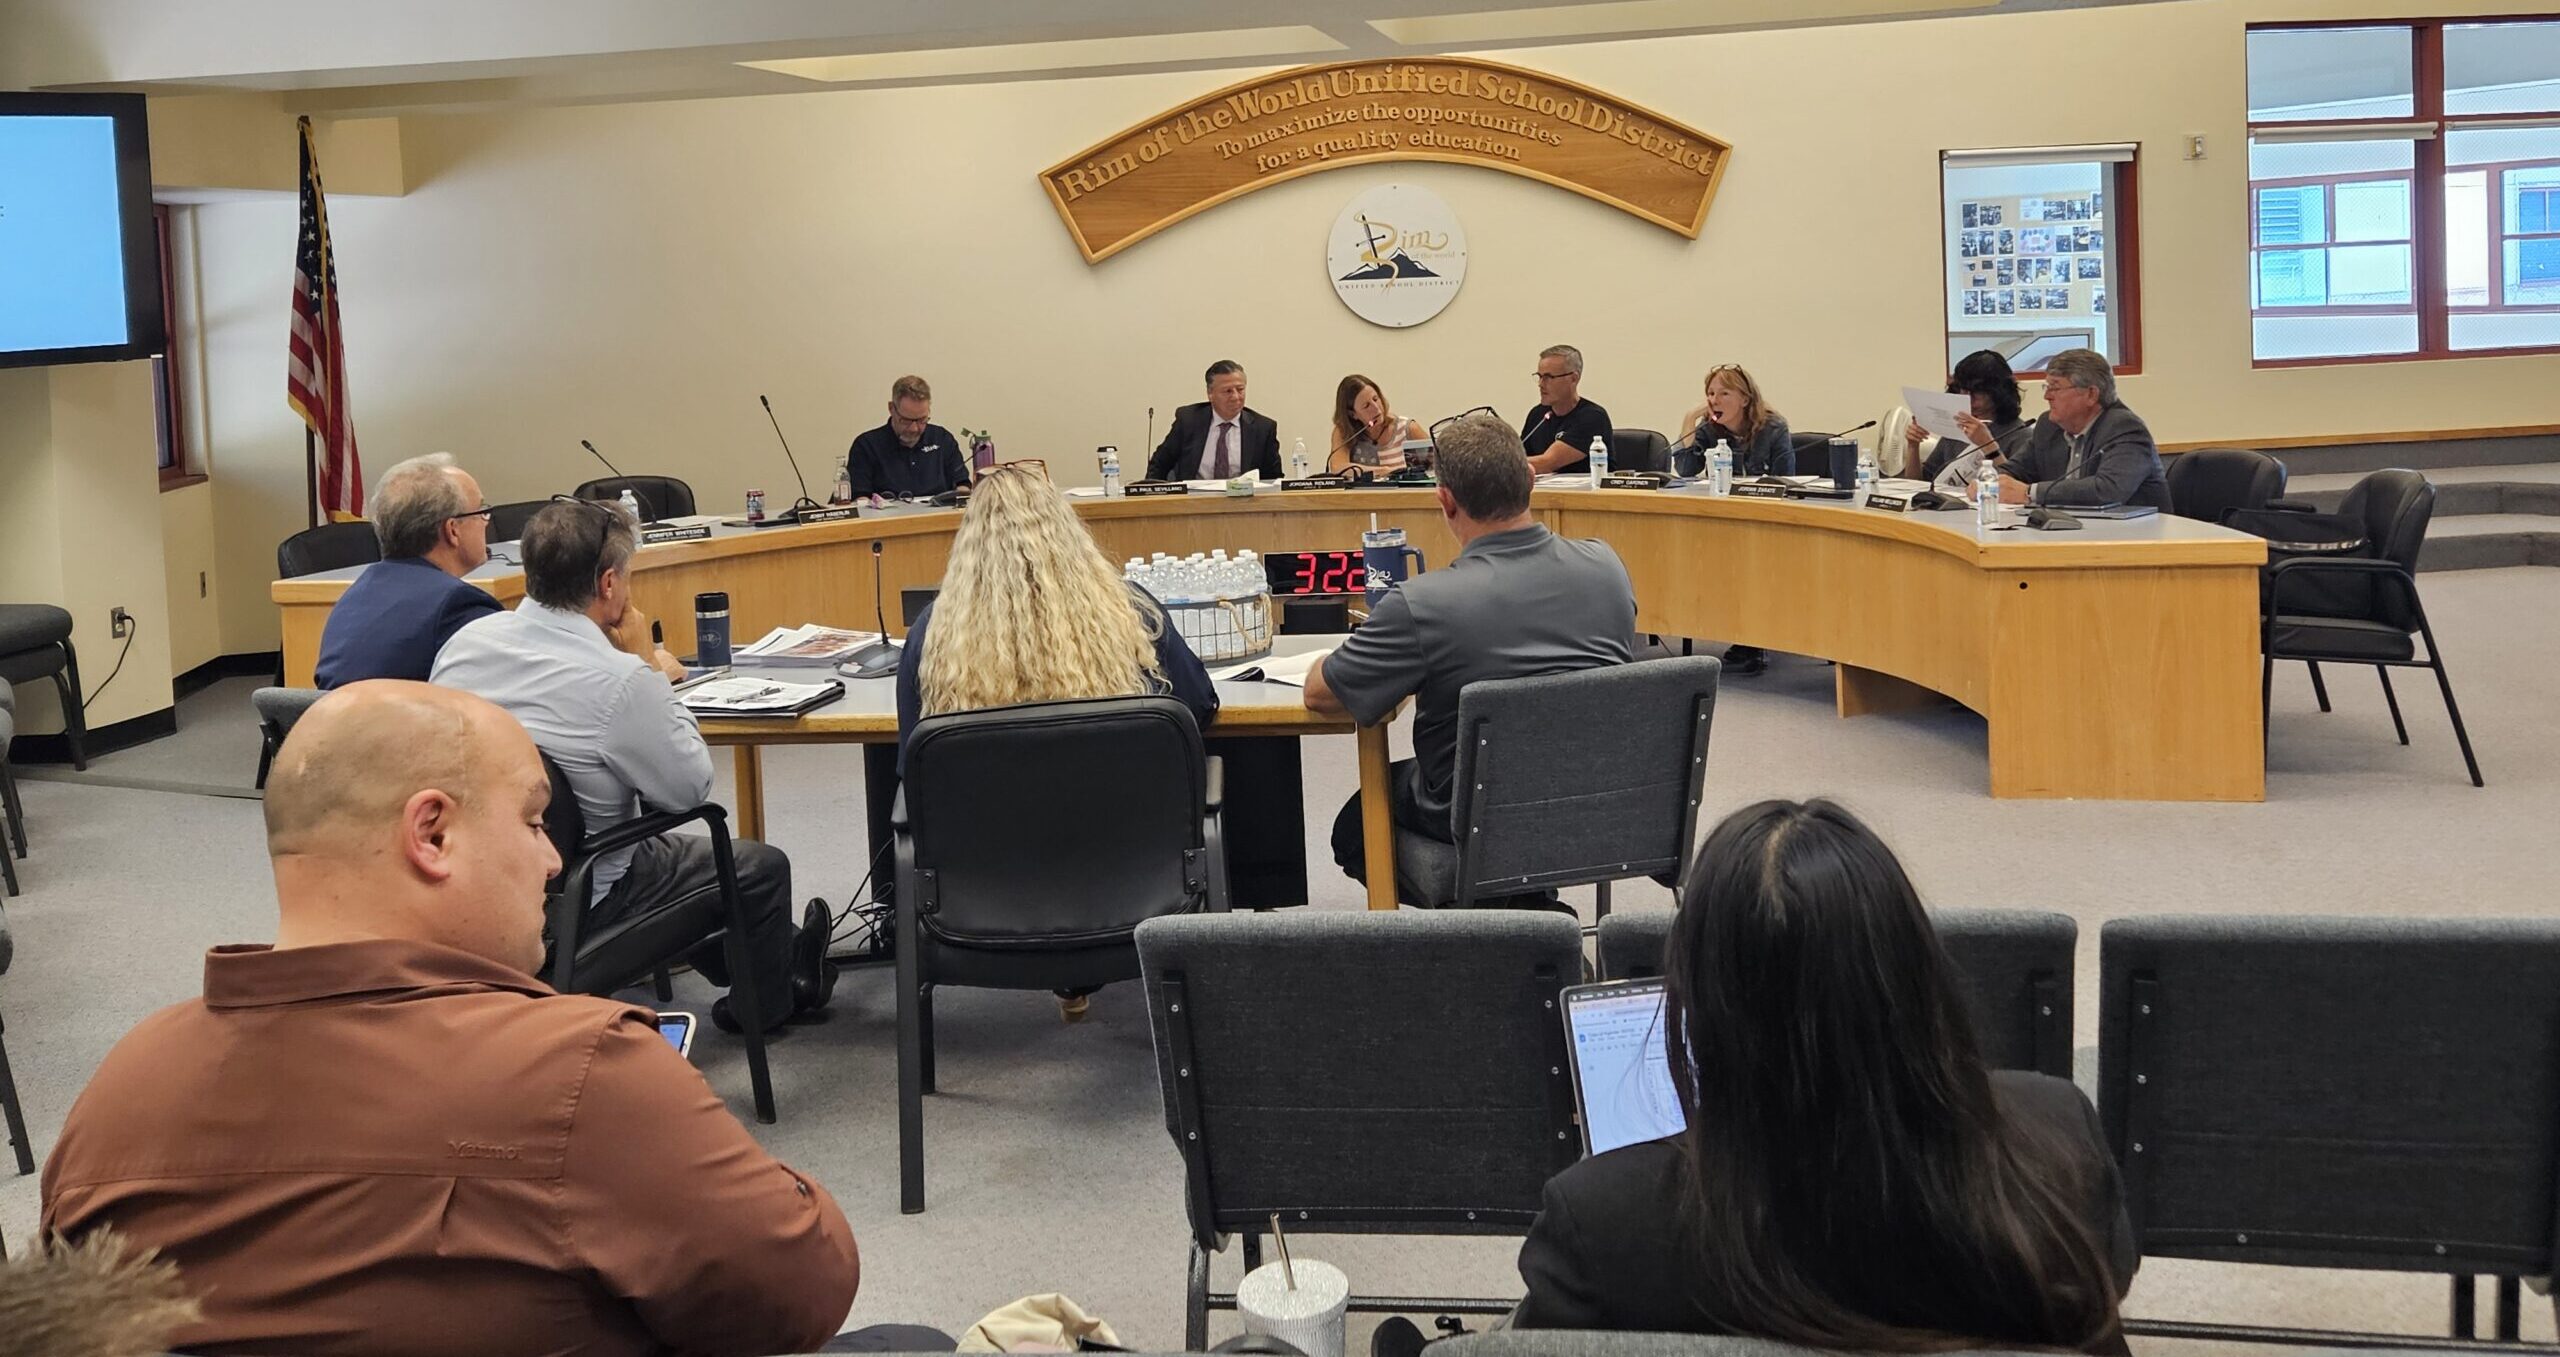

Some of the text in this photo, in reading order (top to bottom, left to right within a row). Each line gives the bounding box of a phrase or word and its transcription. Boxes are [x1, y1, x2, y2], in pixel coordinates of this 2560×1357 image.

[1058, 63, 1715, 202] Rim of the World Unified School District
[1215, 102, 1563, 160] To maximize the opportunities
[1256, 129, 1521, 174] for a quality education
